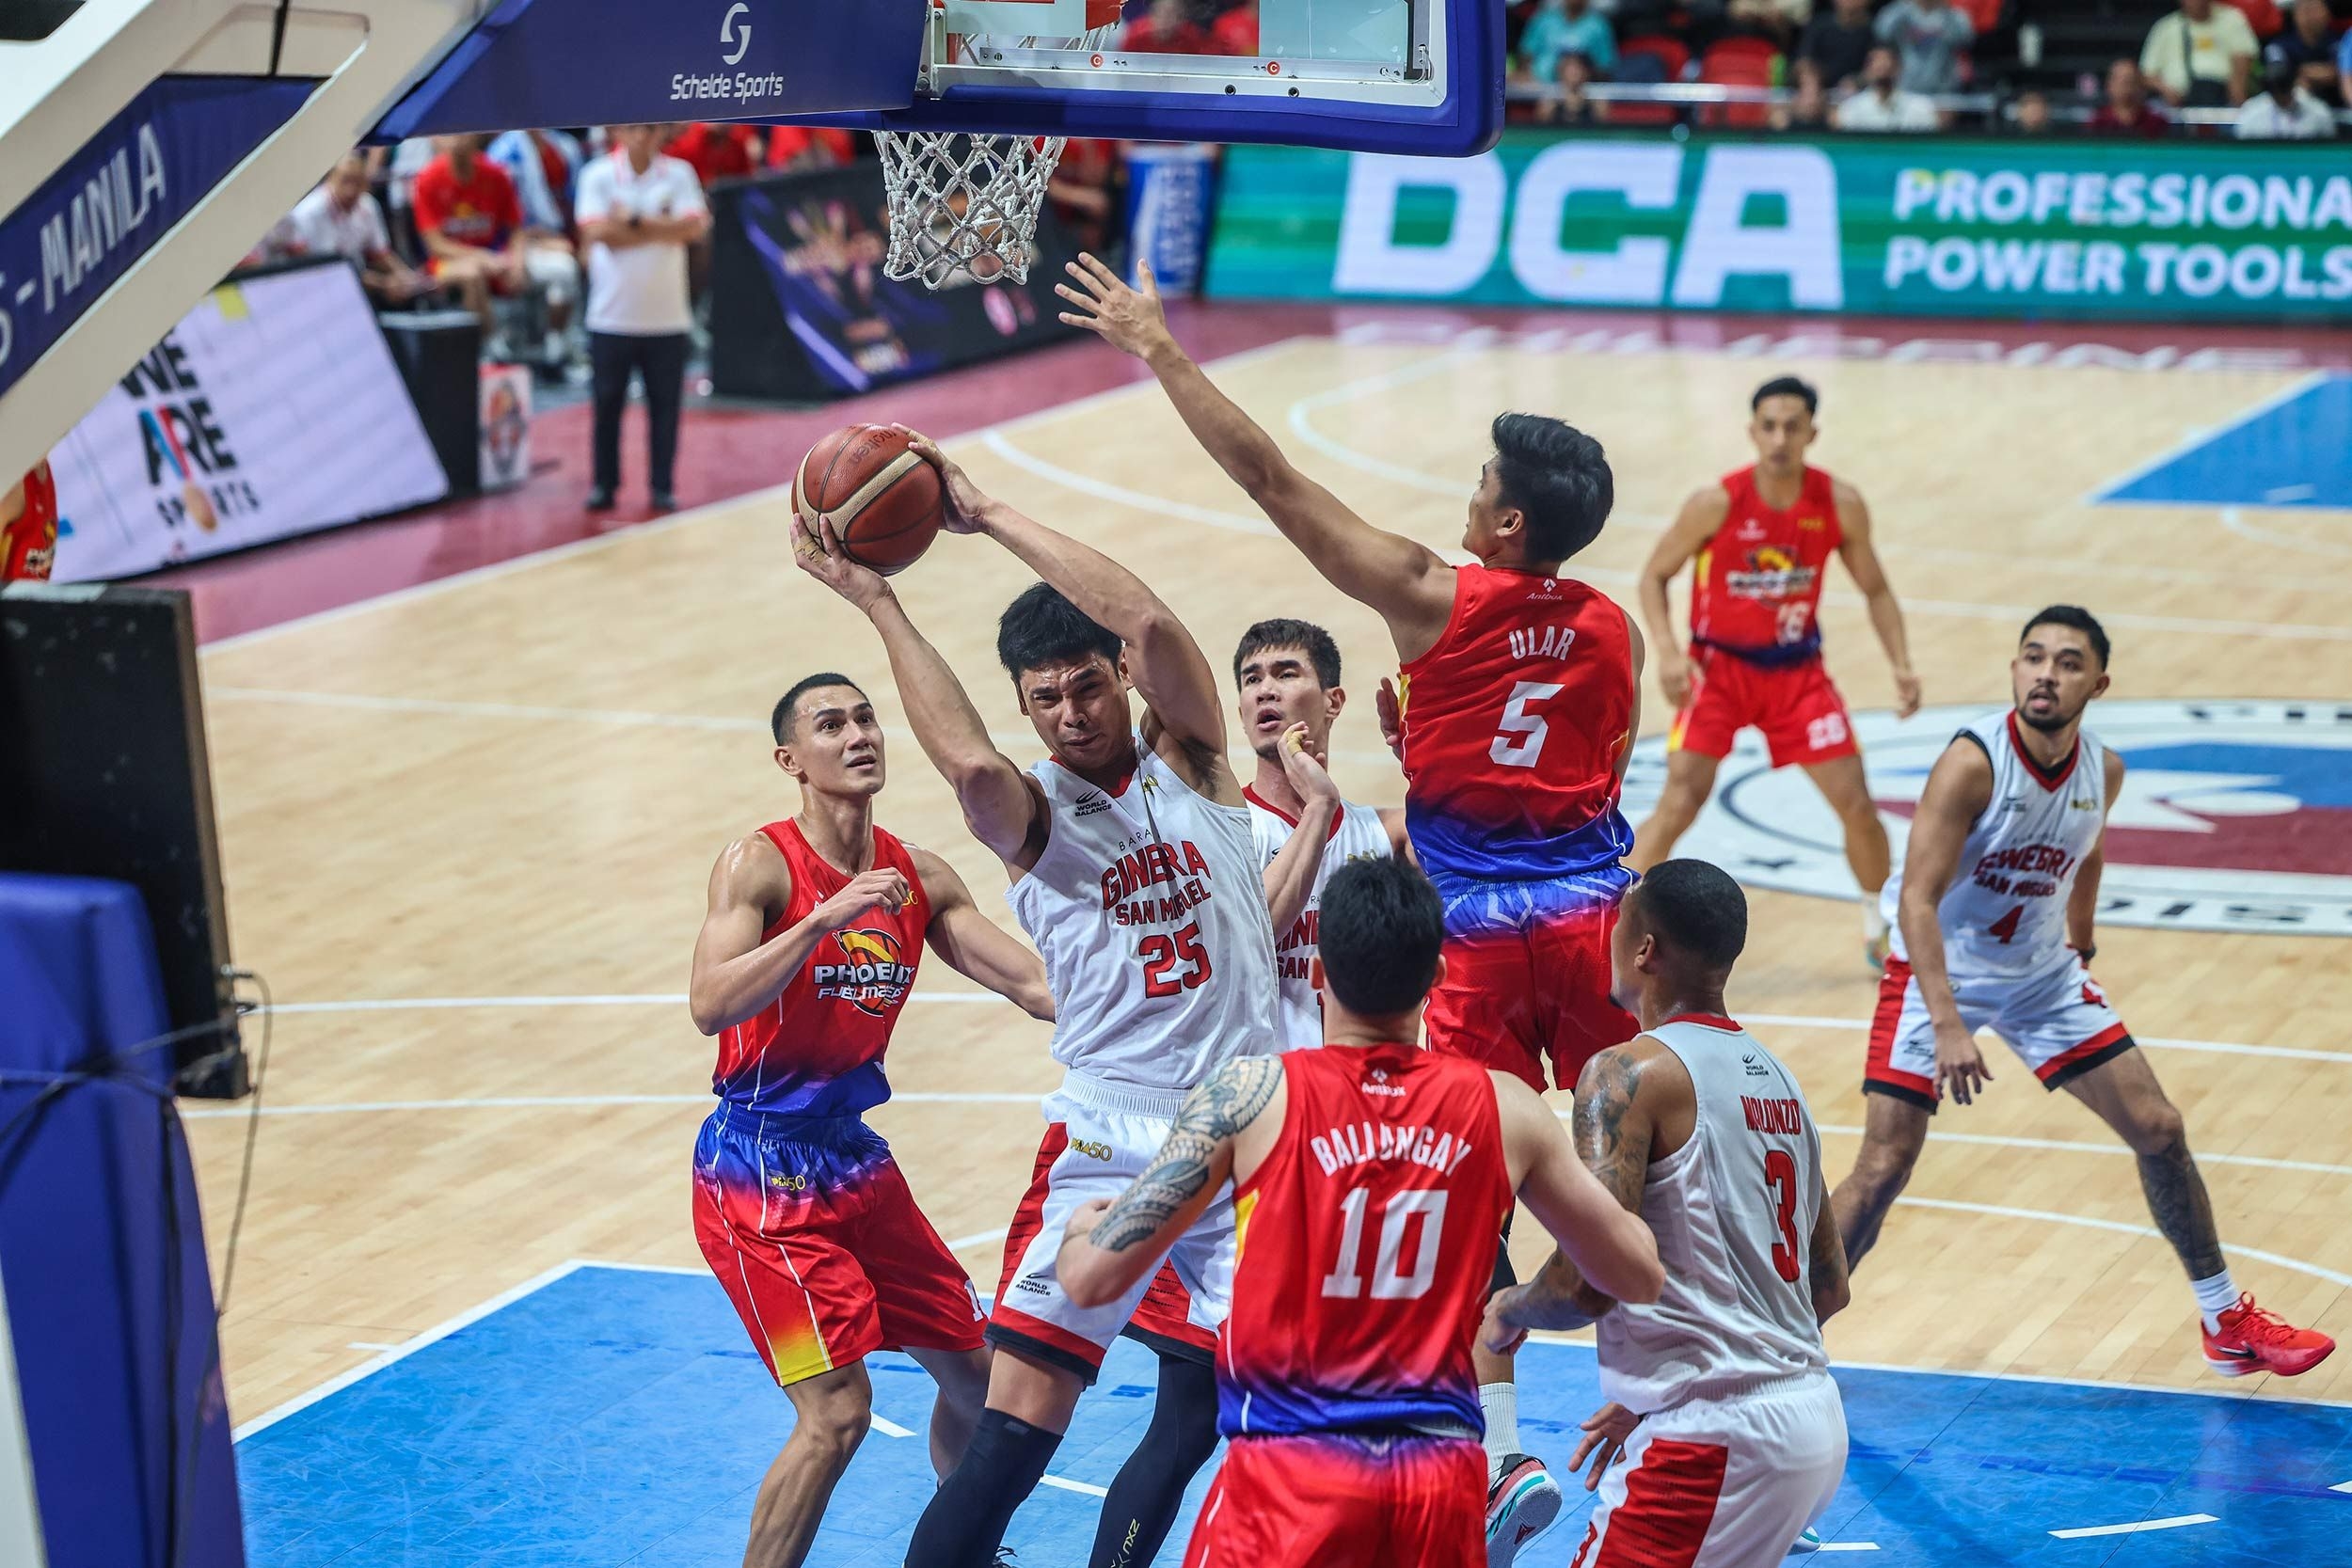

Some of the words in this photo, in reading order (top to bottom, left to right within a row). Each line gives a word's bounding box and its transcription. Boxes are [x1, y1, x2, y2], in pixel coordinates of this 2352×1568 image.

[670, 73, 732, 100] Schelde
[734, 71, 784, 105] Sports
[1333, 140, 1845, 309] DCA
[1893, 167, 2352, 230] PROFESSIONA
[1883, 234, 2126, 295] POWER
[2136, 242, 2352, 300] TOOLS
[1508, 626, 1576, 661] ULAR
[1488, 680, 1566, 768] 5
[1074, 803, 1112, 817] BALANCE
[1076, 799, 1107, 812] WORLD
[1115, 899, 1155, 927] SAN
[1988, 904, 2026, 943] 4
[1138, 919, 1213, 999] 25
[1321, 1186, 1449, 1300] 10
[1763, 1149, 1801, 1283] 3
